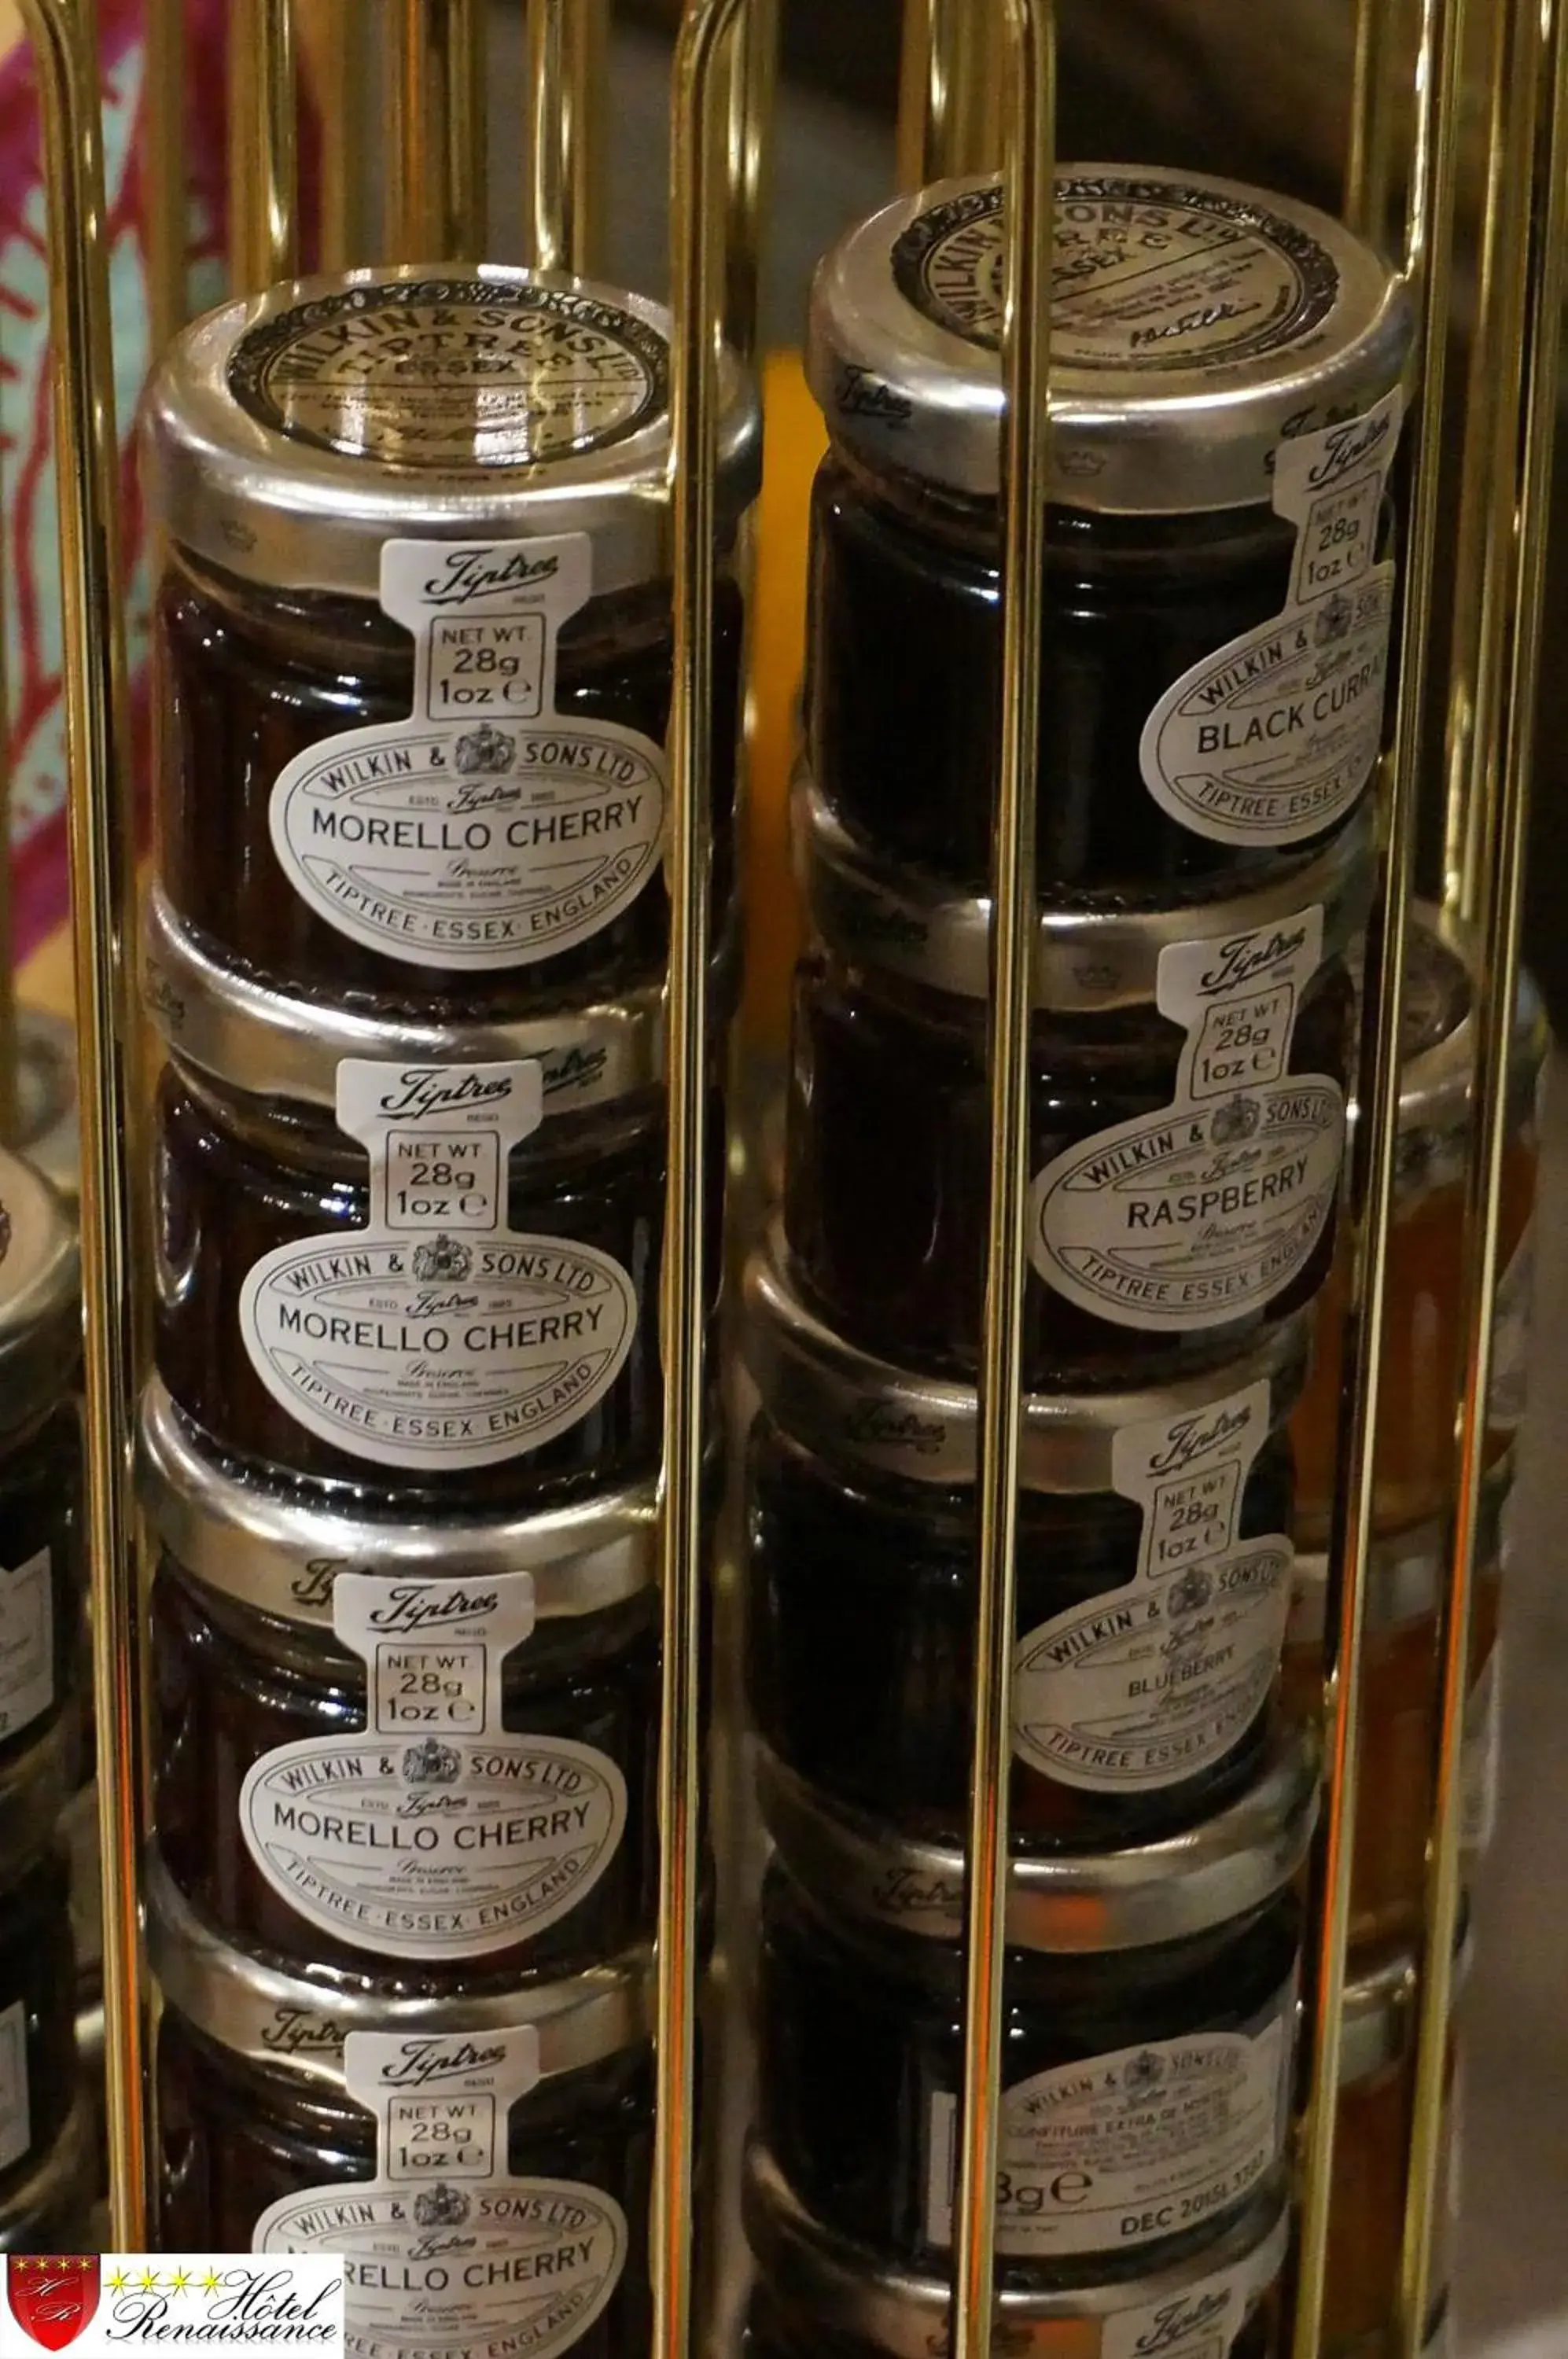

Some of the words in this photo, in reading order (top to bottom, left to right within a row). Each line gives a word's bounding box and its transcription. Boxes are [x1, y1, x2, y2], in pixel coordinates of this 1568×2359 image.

[271, 309, 421, 381] WILKIN
[432, 308, 462, 327] &
[474, 308, 608, 354] SONS
[337, 330, 573, 375] TIPTREE
[1319, 517, 1360, 552] 28g
[419, 548, 559, 605] Tiptree
[1308, 558, 1342, 585] 1oz
[442, 627, 484, 645] NET
[454, 648, 520, 676] 28g
[1199, 638, 1284, 707] WILKIN
[440, 679, 494, 704] 1oz
[1197, 704, 1305, 753] BLACK
[321, 747, 412, 793] WILKIN
[429, 747, 446, 767] &
[525, 742, 591, 767] SONS
[595, 746, 635, 782] LTD
[1198, 781, 1277, 819] TIPTREE
[311, 808, 492, 850] MORELLO
[506, 795, 642, 848] CHERRY
[325, 870, 416, 932] TIPTREE
[433, 920, 516, 940] ESSEX
[530, 857, 631, 933] ENGLAND
[1215, 1024, 1270, 1052] 28g
[1202, 1058, 1245, 1084] 1oz
[377, 1068, 513, 1121] Tiptree
[399, 1143, 440, 1159] NET
[1084, 1132, 1174, 1185] WILKIN
[1188, 1121, 1204, 1143] &
[409, 1162, 477, 1189] 28g
[1126, 1156, 1309, 1231] RASPBERRY
[397, 1190, 451, 1216] 1oz
[287, 1254, 370, 1291] WILKIN
[388, 1255, 404, 1272] &
[481, 1254, 549, 1277] SONS
[554, 1258, 595, 1292] LTD
[1080, 1256, 1171, 1301] TIPTREE
[1182, 1270, 1250, 1302] ESSEX
[278, 1302, 449, 1352] MORELLO
[464, 1305, 605, 1352] CHERRY
[289, 1364, 376, 1427] TIPTREE
[393, 1415, 473, 1437] ESSEX
[488, 1361, 593, 1433] ENGLAND
[1169, 1500, 1218, 1533] 28g
[1158, 1534, 1196, 1561] 1oz
[366, 1584, 499, 1634] Tiptree
[1047, 1610, 1133, 1664] WILKIN
[388, 1654, 429, 1669] NET
[400, 1673, 463, 1698] 28g
[388, 1697, 440, 1720] 1oz
[1047, 1732, 1133, 1768] TIPTREE
[282, 1756, 364, 1792] WILKIN
[379, 1757, 394, 1776] &
[472, 1756, 538, 1781] SONS
[541, 1761, 583, 1794] LTD
[273, 1802, 439, 1850] MORELLO
[454, 1801, 591, 1850] CHERRY
[286, 1857, 370, 1921] TIPTREE
[385, 1912, 466, 1931] ESSEX
[478, 1857, 581, 1927] ENGLAND
[377, 2039, 506, 2087] Tiptree
[399, 2106, 437, 2121] NET
[411, 2122, 471, 2144] 28g
[399, 2146, 450, 2167] 1oz
[295, 2203, 374, 2239] WILKIN
[392, 2203, 406, 2220] &
[479, 2199, 540, 2220] SONS
[546, 2203, 587, 2231] LTD
[1121, 2207, 1174, 2236] DEC
[463, 2238, 595, 2289] CHERRY
